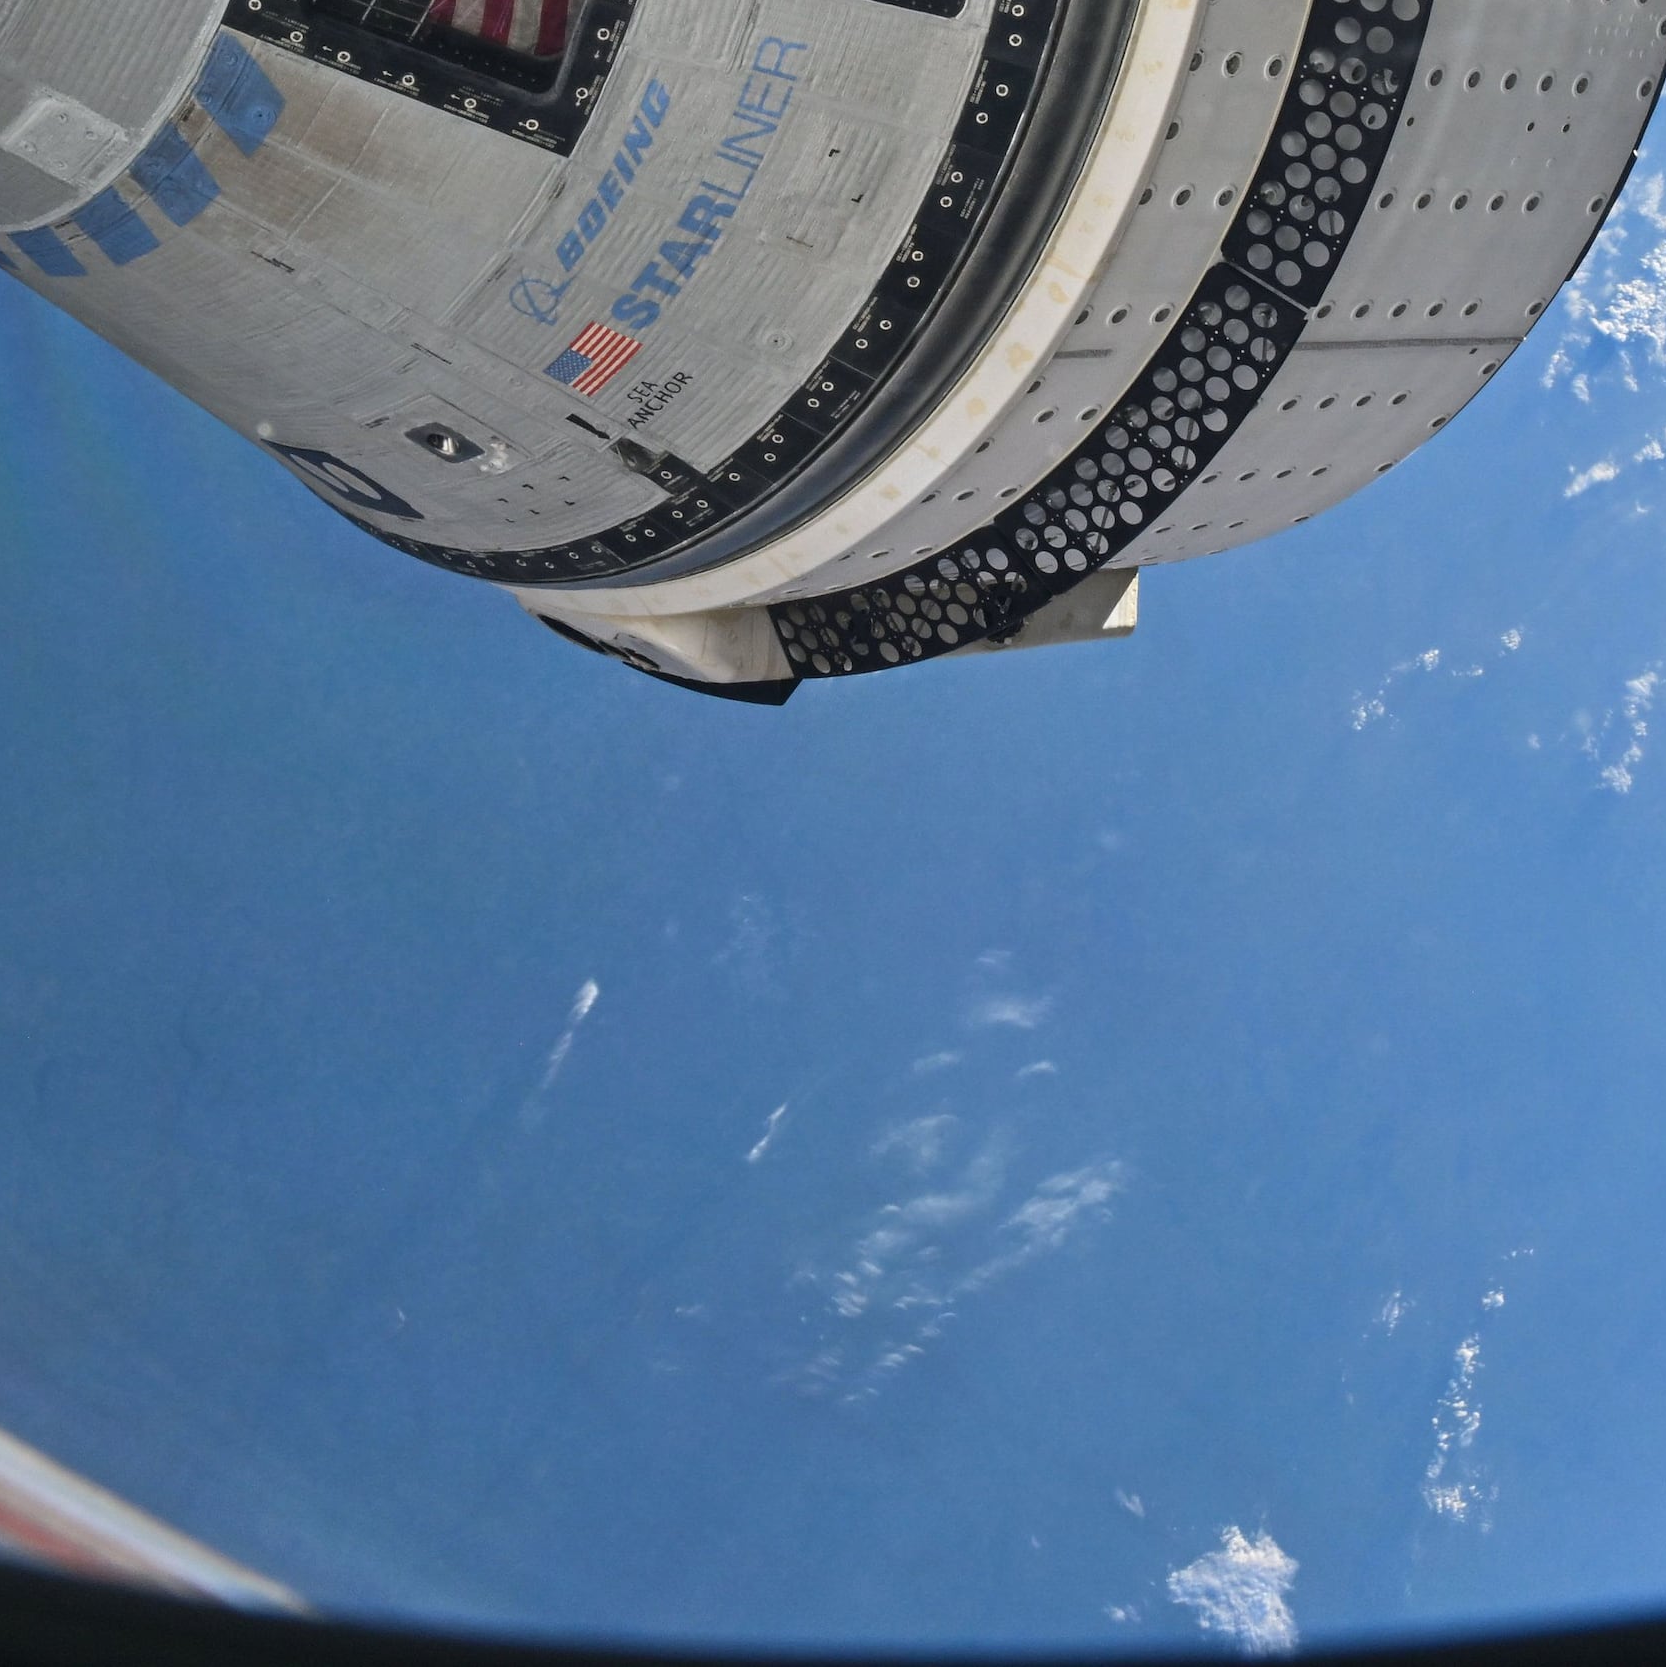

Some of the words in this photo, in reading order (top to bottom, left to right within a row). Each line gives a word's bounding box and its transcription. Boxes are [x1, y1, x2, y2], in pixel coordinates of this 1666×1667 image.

[554, 77, 672, 272] BOEING
[611, 35, 809, 331] STARLINER
[627, 380, 659, 404] SEA
[627, 371, 694, 430] ANCHOR
